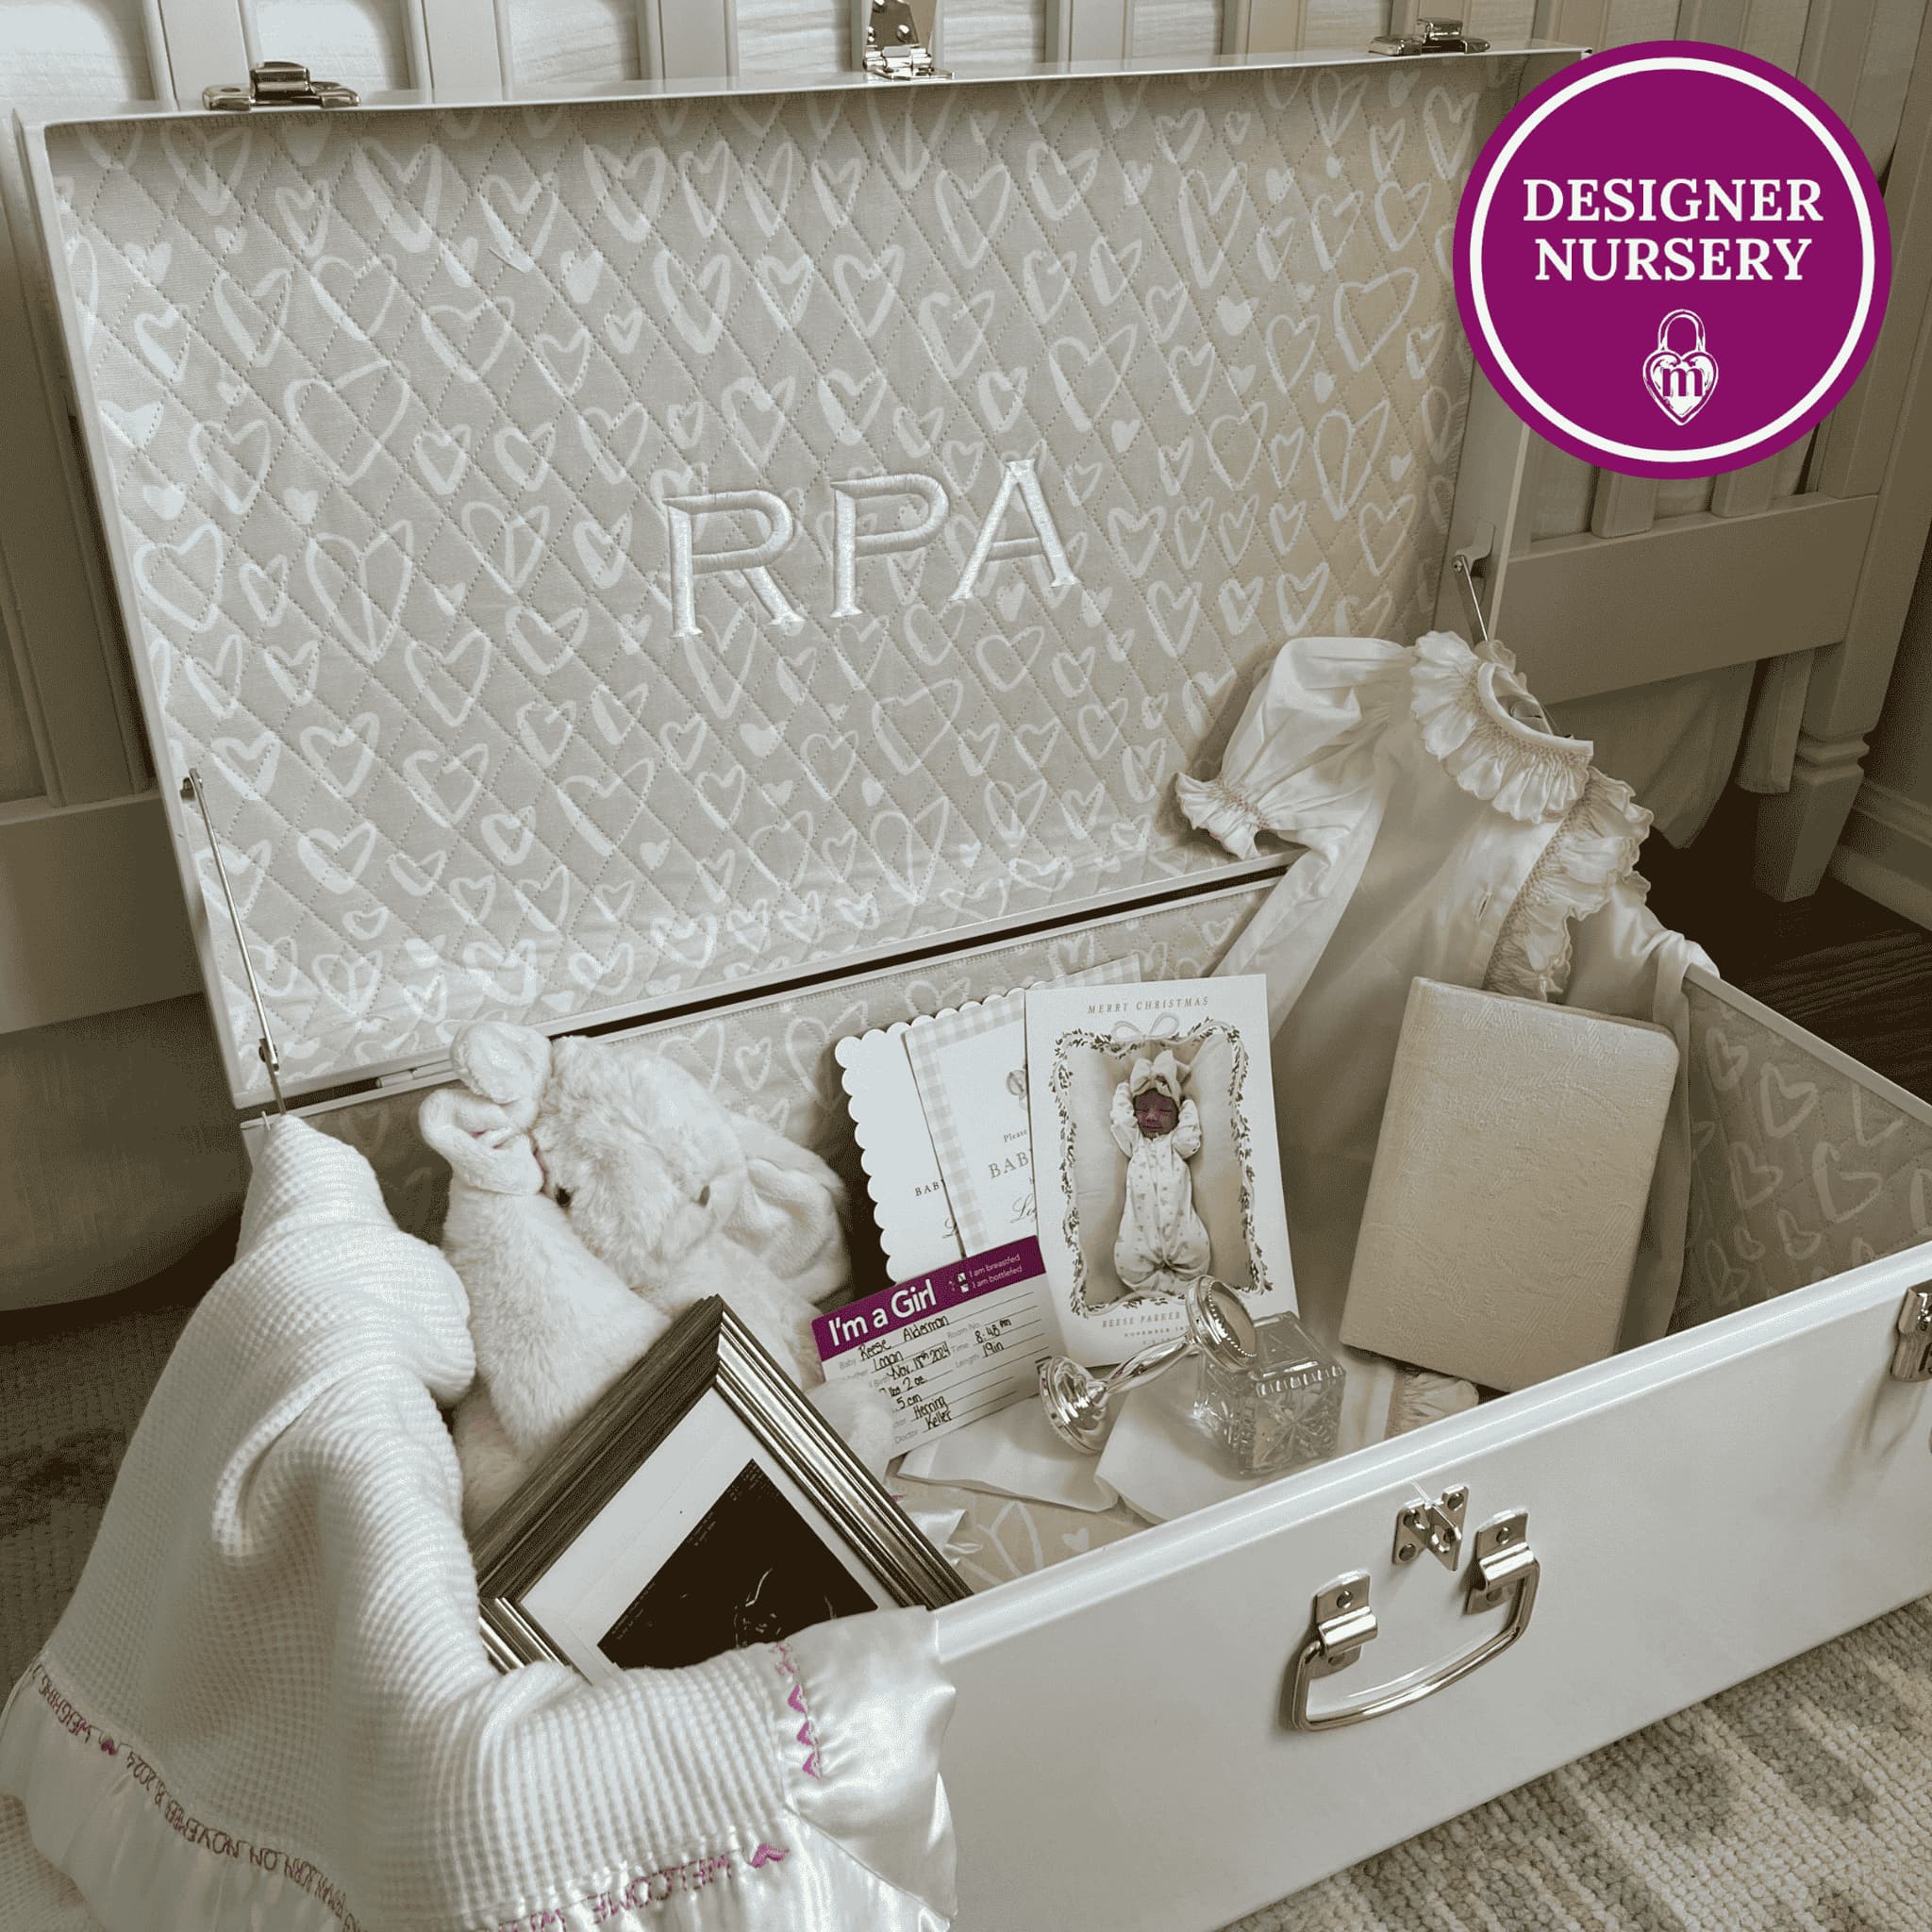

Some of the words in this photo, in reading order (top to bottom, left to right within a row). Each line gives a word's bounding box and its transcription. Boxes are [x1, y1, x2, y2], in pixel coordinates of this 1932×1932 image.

[662, 458, 1081, 638] RPA
[1087, 1003, 1129, 1014] MERRY
[1135, 996, 1208, 1010] CHRISTMAS
[988, 1148, 1033, 1179] BAB
[914, 1181, 941, 1197] BAB
[985, 1253, 1021, 1272] breastfed
[988, 1265, 1023, 1283] bottlefed
[828, 1316, 869, 1347] I'm
[872, 1307, 889, 1328] a
[891, 1278, 937, 1319] Girl
[39, 1674, 92, 1743] WEIGHING
[126, 1751, 157, 1790] 2024
[165, 1799, 239, 1858] NOVEMBER
[249, 1846, 277, 1871] ON
[587, 1853, 733, 1925] WELCOME
